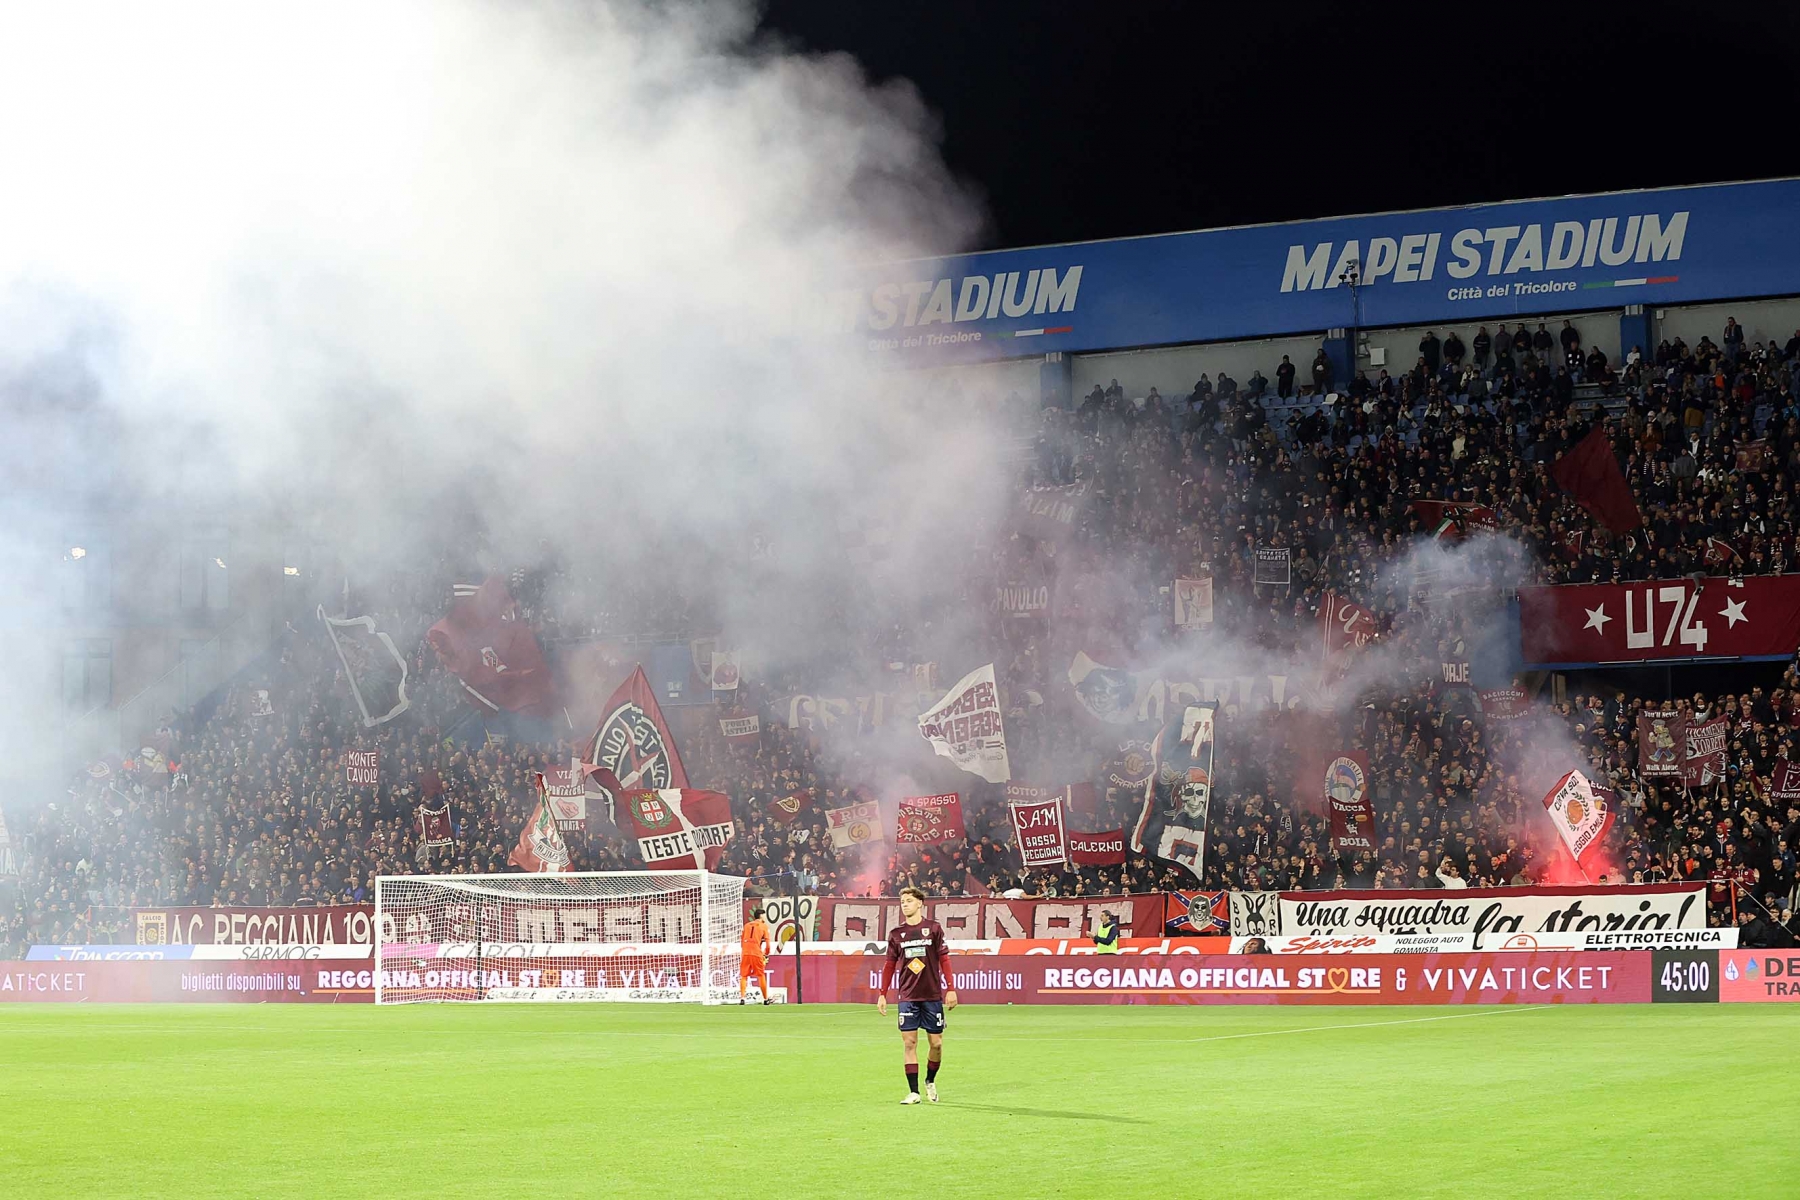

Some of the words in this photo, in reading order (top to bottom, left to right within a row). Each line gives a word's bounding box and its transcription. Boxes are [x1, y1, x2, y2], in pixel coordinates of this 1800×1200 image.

[1280, 233, 1441, 293] MAPEI
[1447, 211, 1690, 279] STADIUM
[868, 266, 1083, 331] STADIUM
[1447, 285, 1482, 301] Città
[1487, 284, 1508, 297] del
[1513, 279, 1577, 295] Tricolore
[903, 334, 922, 348] del
[926, 329, 981, 346] Tricolore
[996, 586, 1048, 611] PAVULLO
[1625, 585, 1708, 652] U74
[1441, 662, 1470, 683] DAJE
[1482, 690, 1524, 700] BACIOCCHI
[1486, 709, 1528, 720] SCANDIANO
[347, 751, 377, 767] MONTE
[346, 766, 378, 783] CAVOLO
[1109, 773, 1149, 789] GRANAT
[1007, 786, 1037, 797] SOTTO
[917, 795, 956, 807] SPASSO
[1332, 801, 1366, 812] VACCA
[841, 806, 868, 821] RIO
[642, 832, 693, 860] TESTE
[1025, 833, 1056, 848] BASSA
[1070, 840, 1123, 853] CALERNO
[1339, 837, 1371, 848] BOIA
[1024, 845, 1063, 860] REGGIANA
[1296, 902, 1351, 928] Una
[1354, 900, 1470, 933] squadra
[214, 913, 335, 945] REGGIANA
[1281, 936, 1376, 953] Spirito
[1395, 937, 1439, 945] NOLEGGIO
[1440, 936, 1464, 944] AUTO
[1585, 931, 1721, 945] ELETTROTECNICA
[239, 946, 321, 959] SARMOG
[181, 973, 224, 992] biglietti
[226, 971, 285, 993] disponibili
[288, 976, 300, 989] su
[424, 970, 513, 988] OFFICIAL
[1005, 973, 1022, 990] su
[1045, 968, 1175, 988] REGGIANA
[1179, 968, 1290, 988] OFFICIAL
[1396, 968, 1407, 991] &
[1423, 967, 1611, 991] VIVATICKET
[1660, 961, 1709, 991] 45:00
